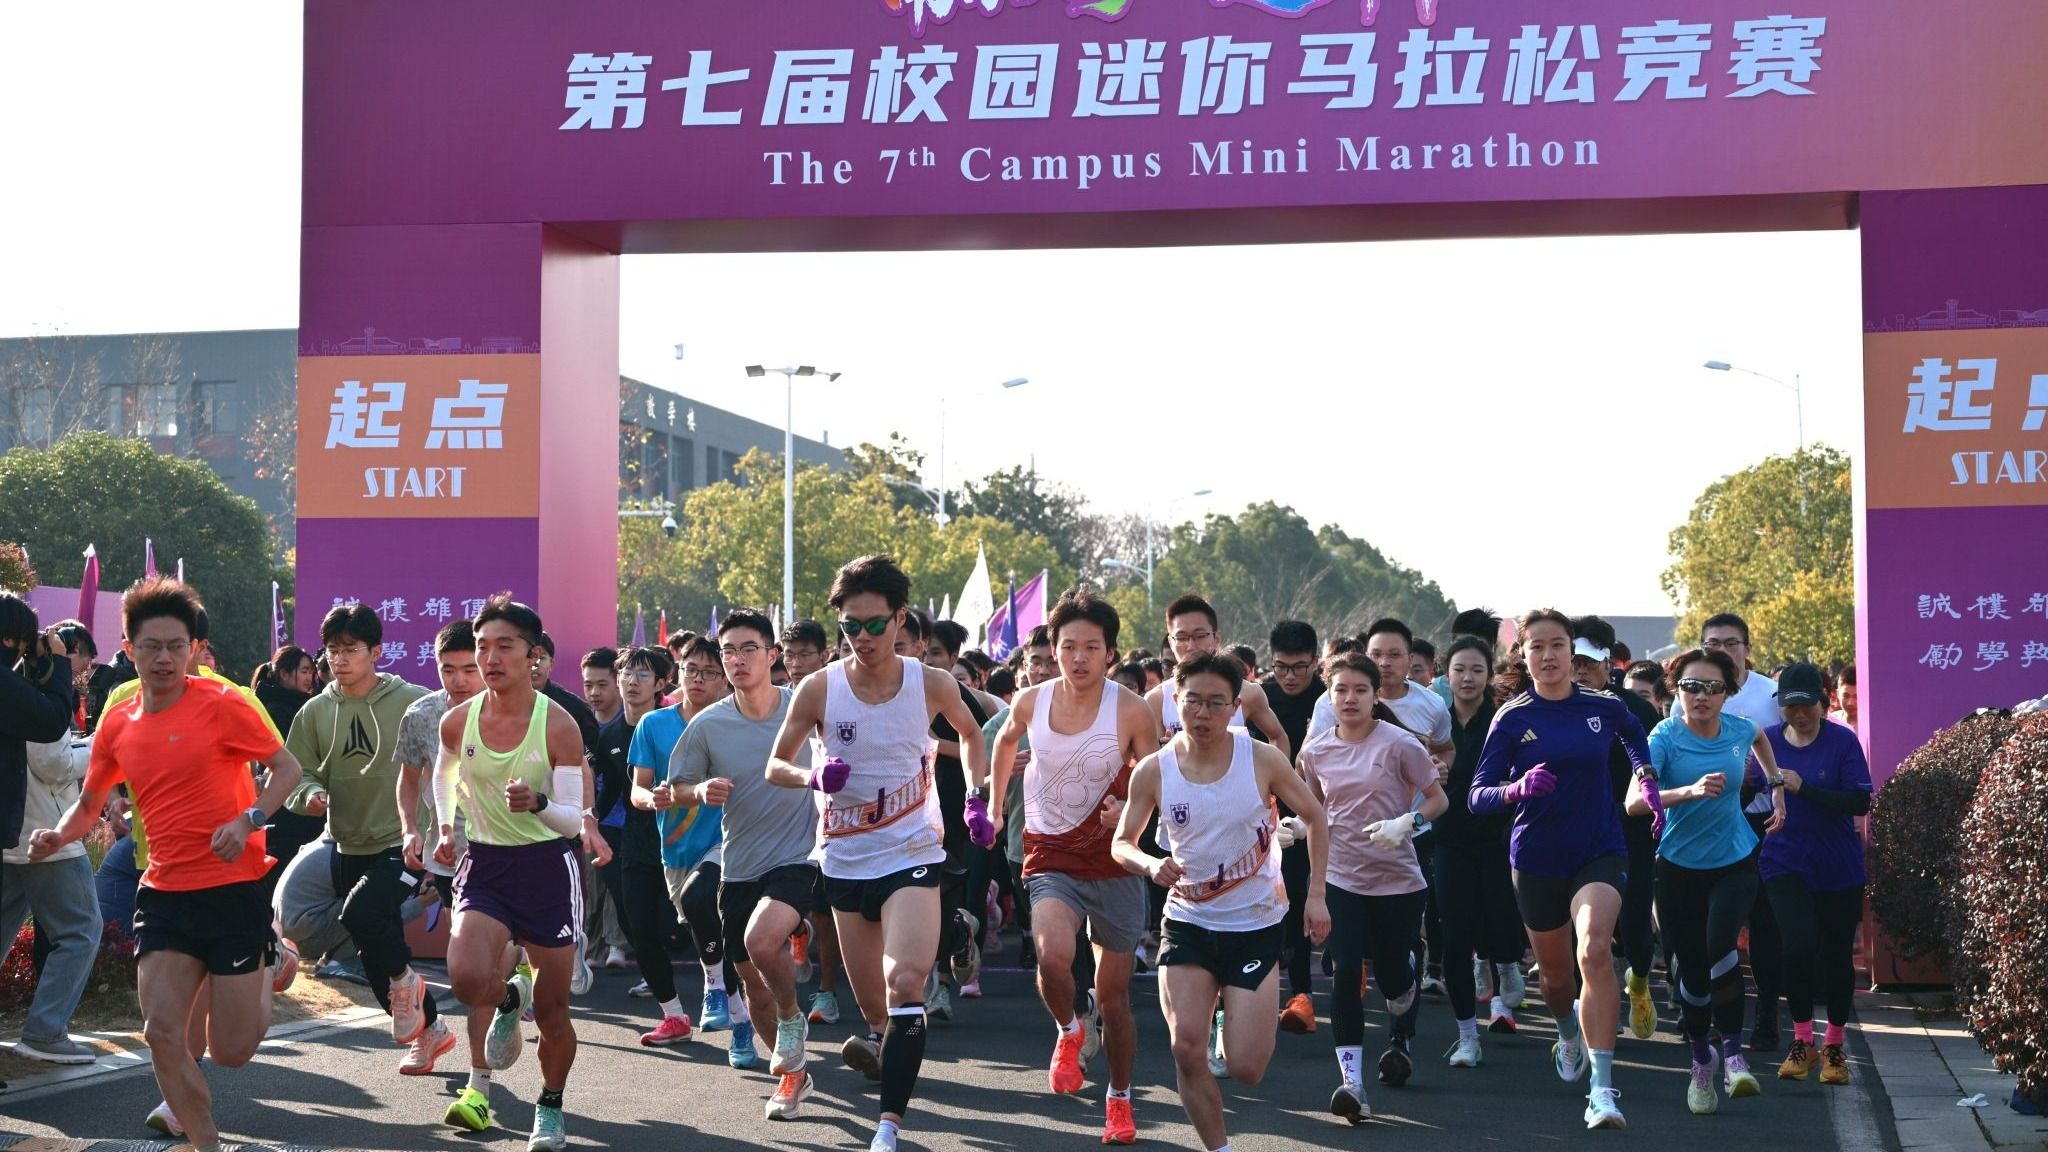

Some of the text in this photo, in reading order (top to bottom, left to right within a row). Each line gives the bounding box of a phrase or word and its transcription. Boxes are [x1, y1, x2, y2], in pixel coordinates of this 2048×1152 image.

[558, 15, 1826, 130] 第七届校园迷你马拉松竞赛
[764, 132, 1600, 189] The 7th Campus Mini Marathon
[324, 379, 509, 449] 起点
[362, 466, 468, 498] START
